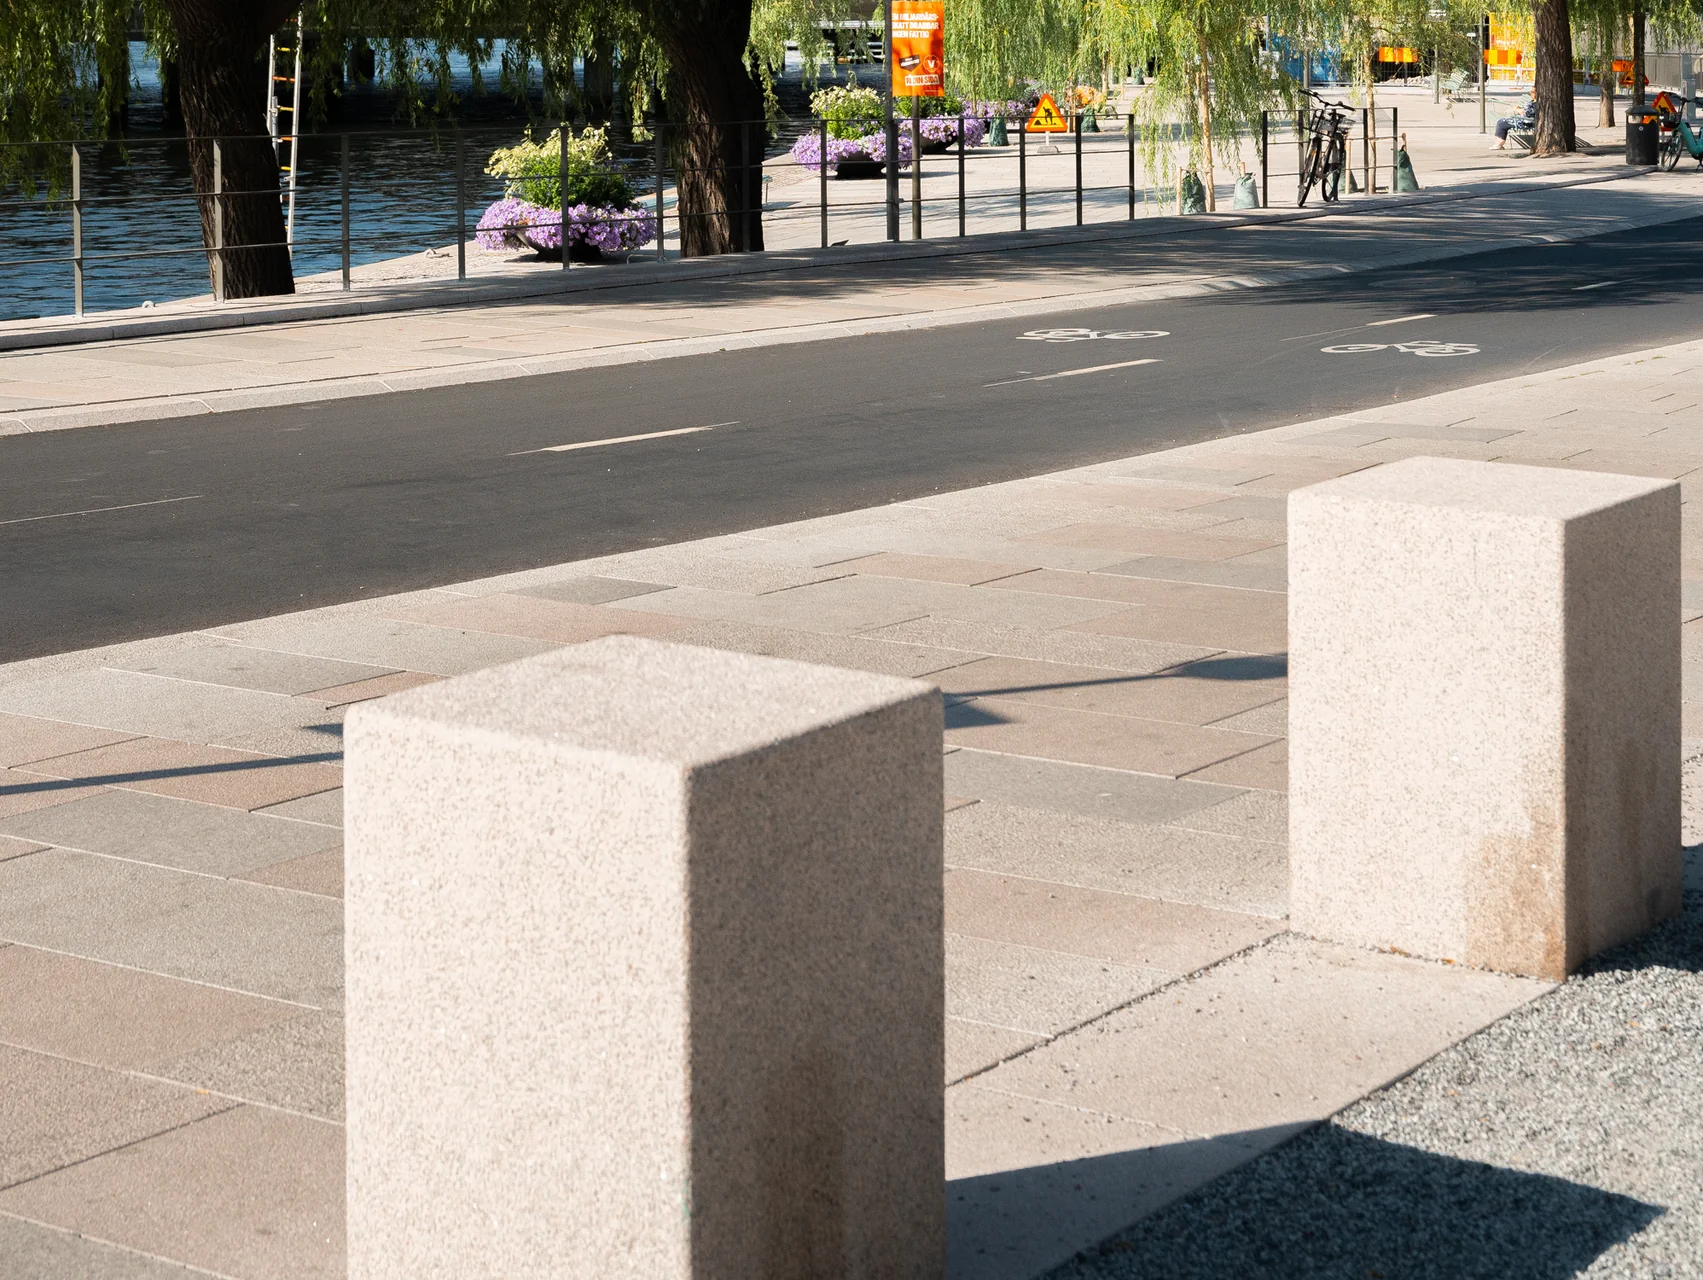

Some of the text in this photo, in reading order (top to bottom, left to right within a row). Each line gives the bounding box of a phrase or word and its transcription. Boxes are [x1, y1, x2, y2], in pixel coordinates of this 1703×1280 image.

[910, 22, 939, 30] DRABBAR
[909, 30, 929, 38] FATTIG
[913, 76, 923, 84] DIN
